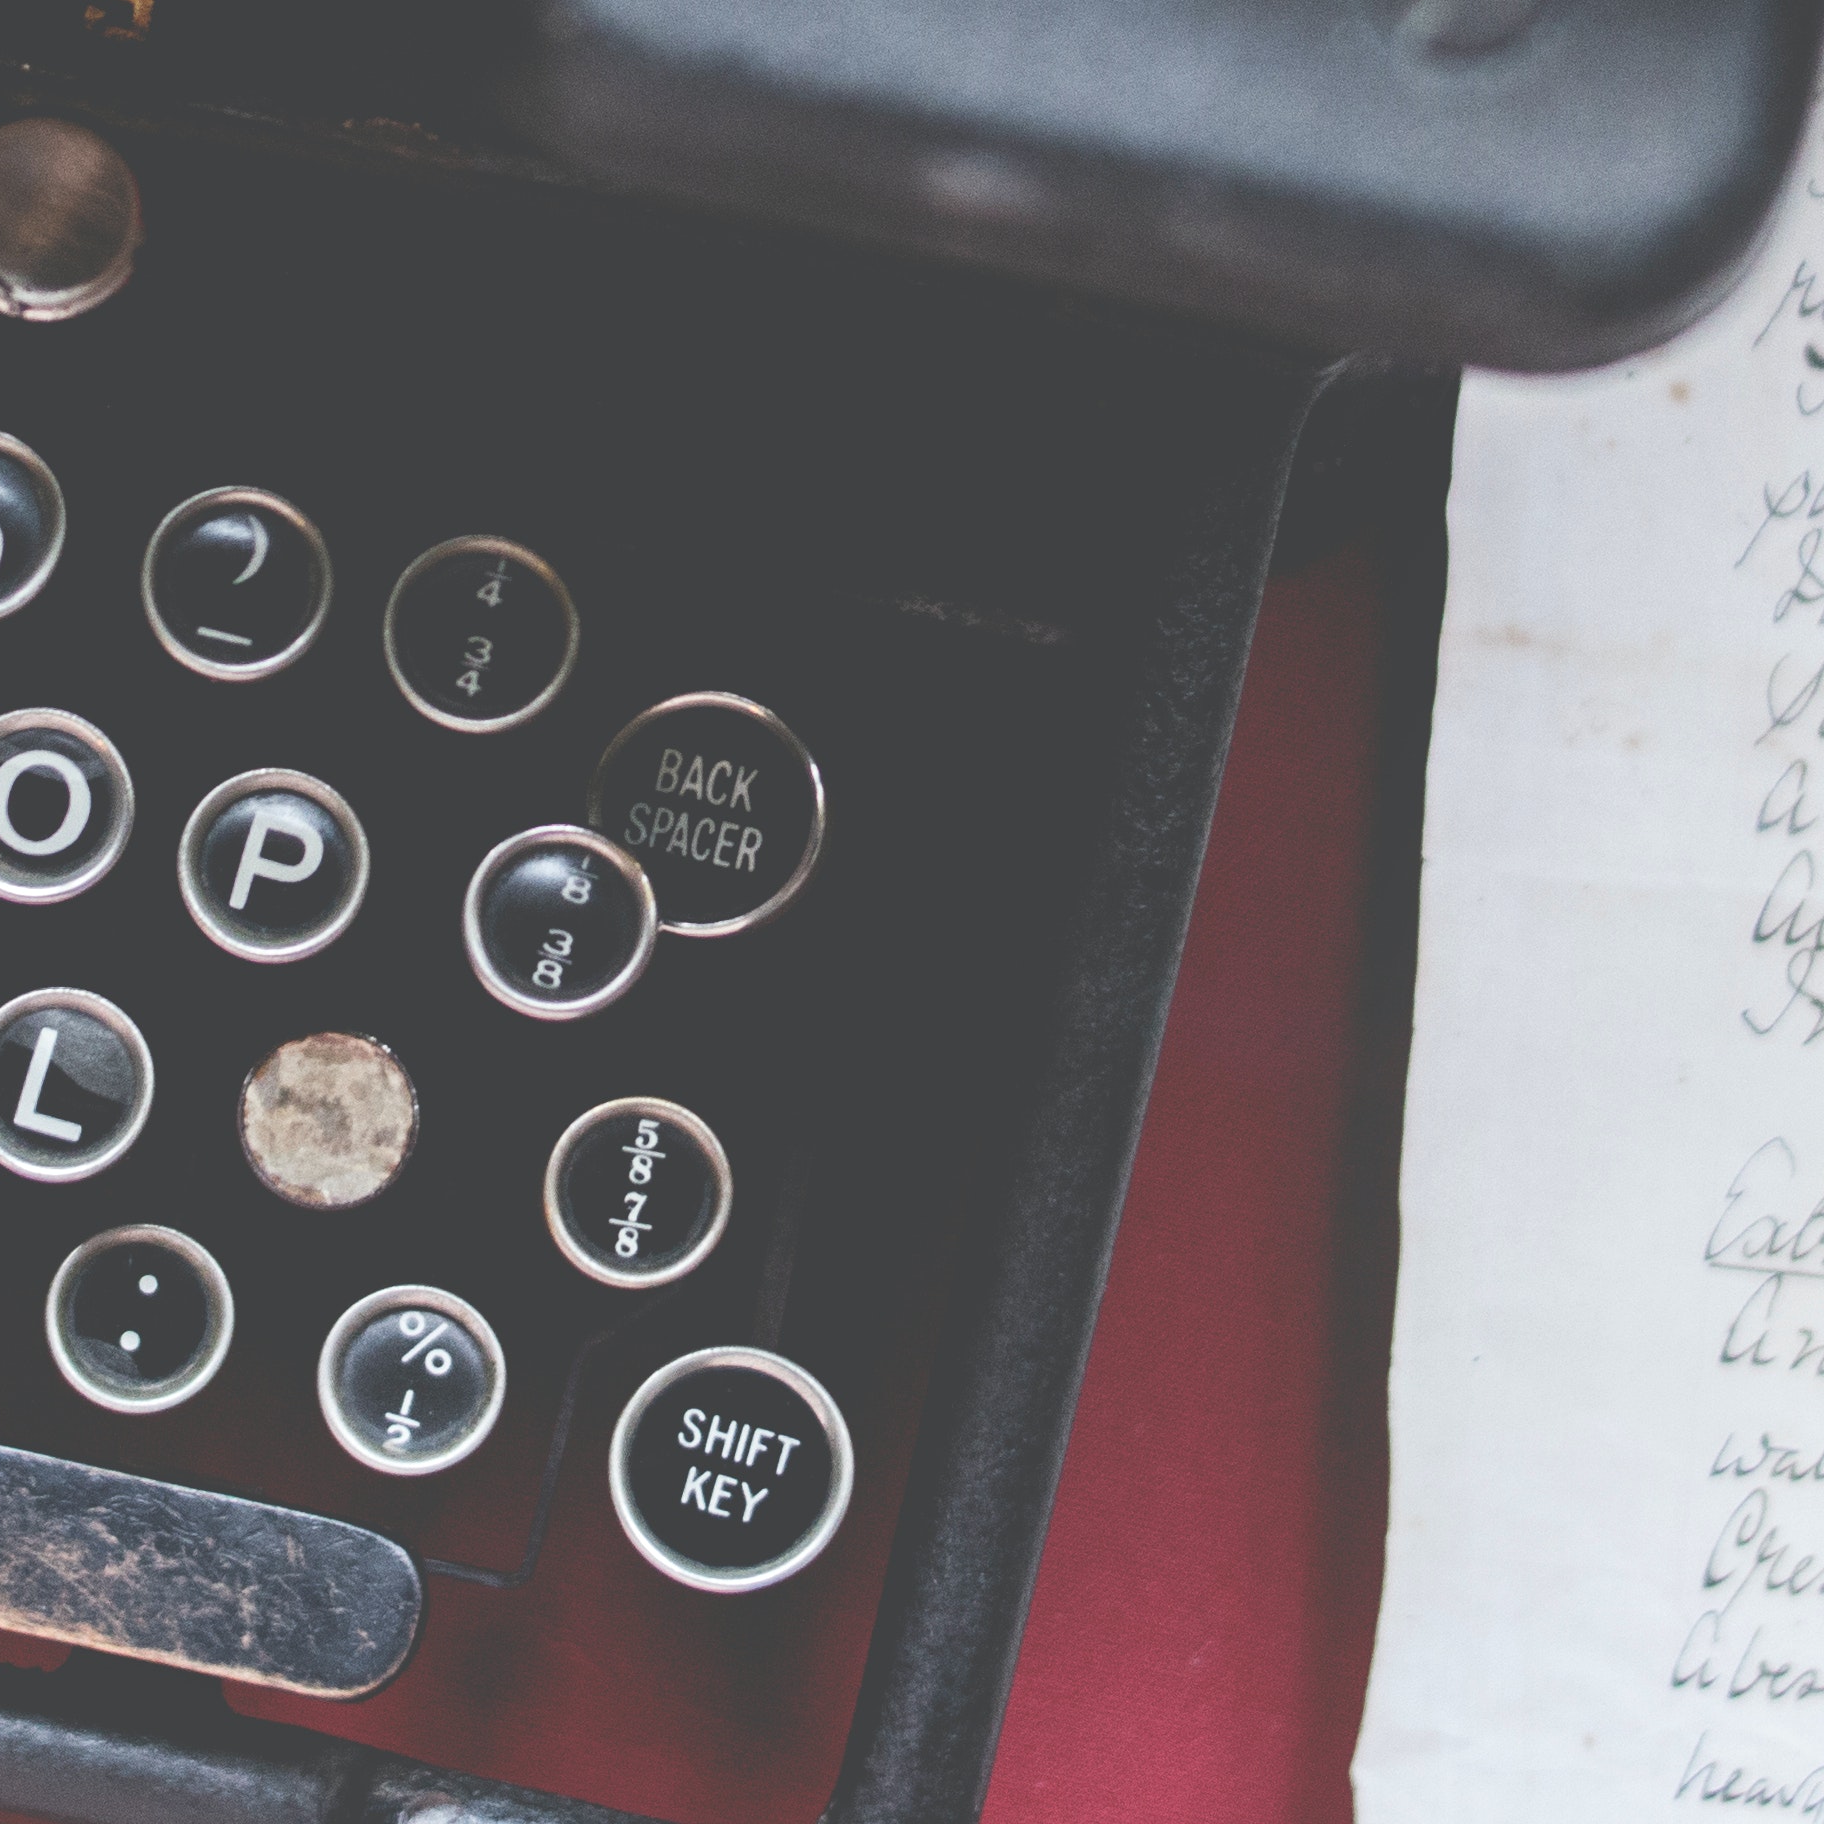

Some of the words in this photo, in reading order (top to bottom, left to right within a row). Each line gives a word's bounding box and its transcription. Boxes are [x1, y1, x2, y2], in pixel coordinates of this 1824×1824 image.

[654, 748, 760, 812] BACK
[228, 808, 325, 911] P
[623, 802, 764, 873] SPACER
[13, 1026, 83, 1144] L
[398, 1309, 454, 1376] %
[676, 1407, 801, 1477] SHIFT
[680, 1466, 769, 1524] KEY
